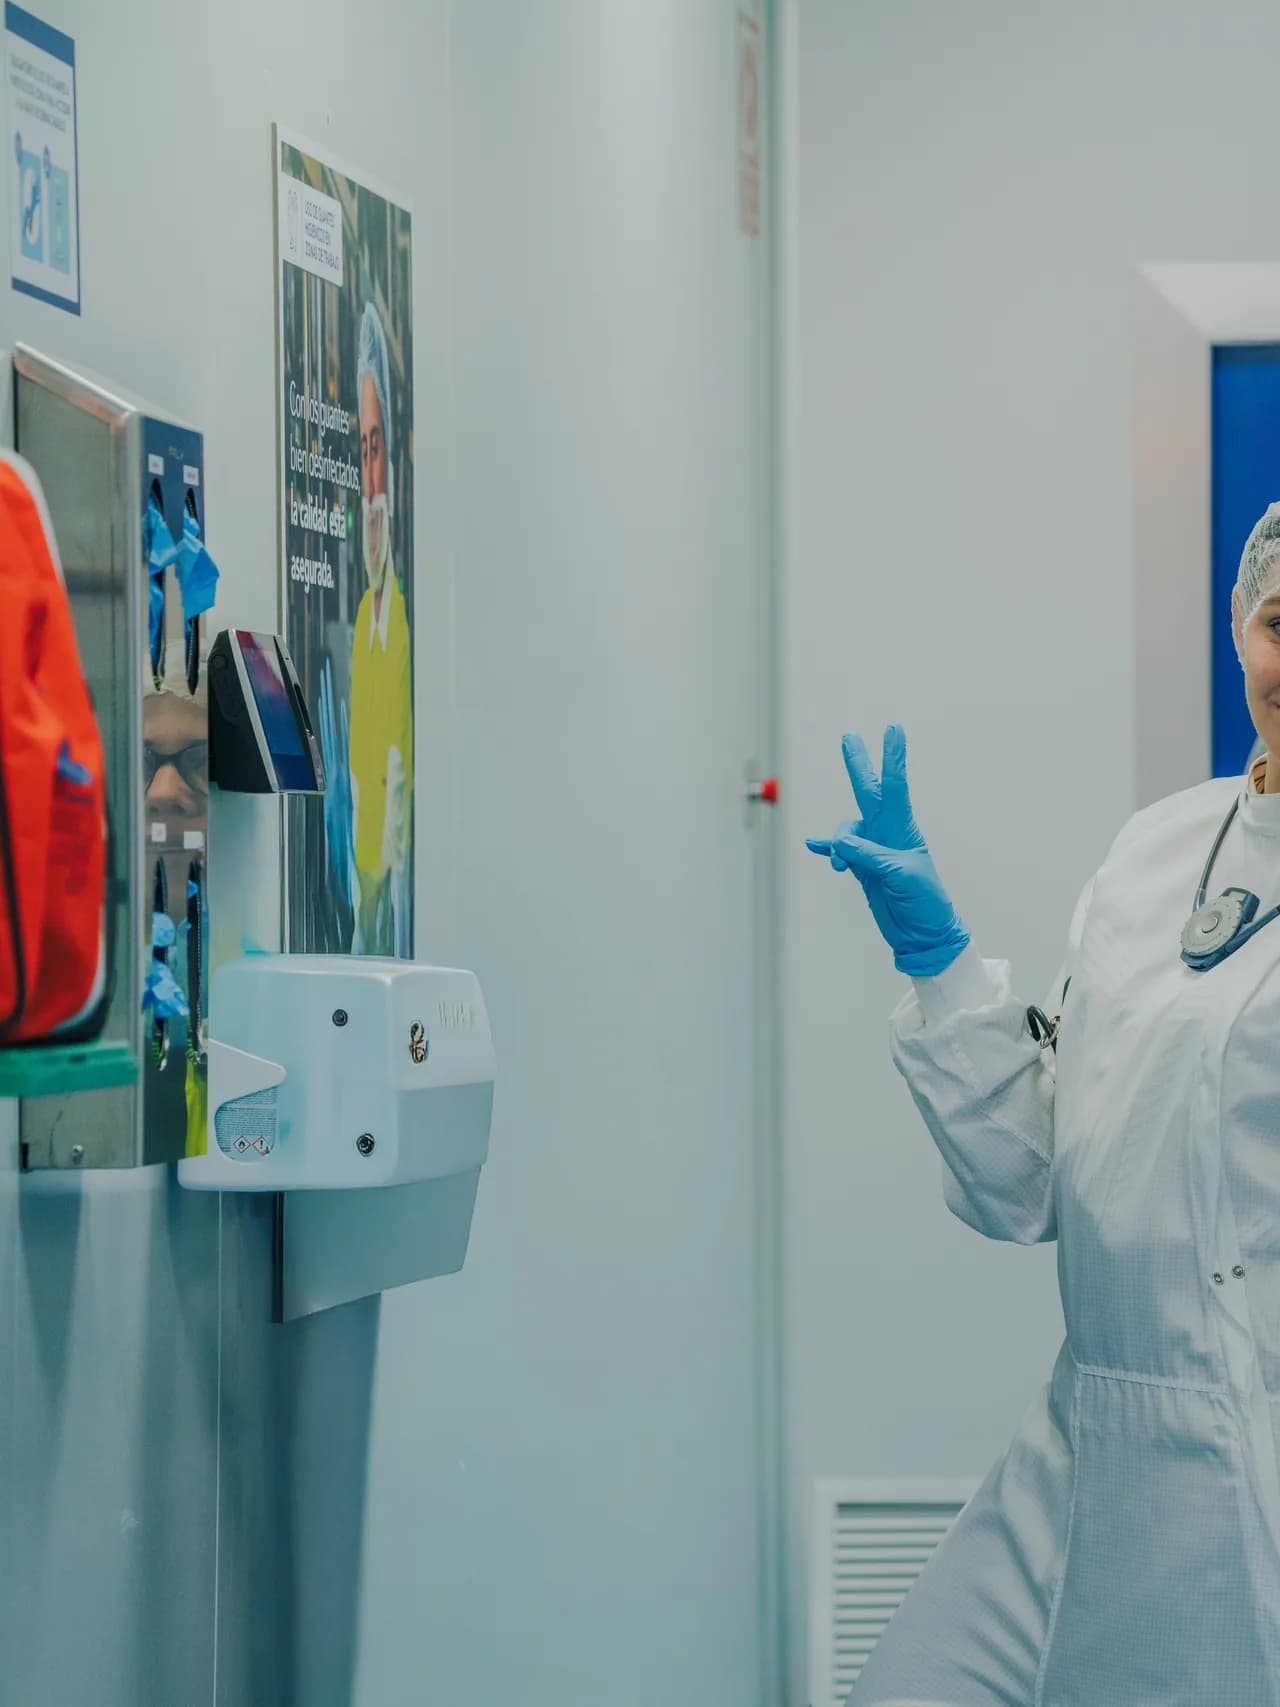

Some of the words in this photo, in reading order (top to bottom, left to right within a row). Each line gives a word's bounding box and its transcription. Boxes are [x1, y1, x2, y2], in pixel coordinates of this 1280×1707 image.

[289, 380, 305, 419] Con
[307, 384, 319, 424] los
[320, 403, 349, 437] guantes
[290, 432, 307, 474] bien
[309, 440, 360, 496] desinfectados,
[290, 481, 298, 526] la
[300, 492, 328, 534] calidad
[329, 505, 346, 539] está
[291, 551, 334, 594] asegurada.
